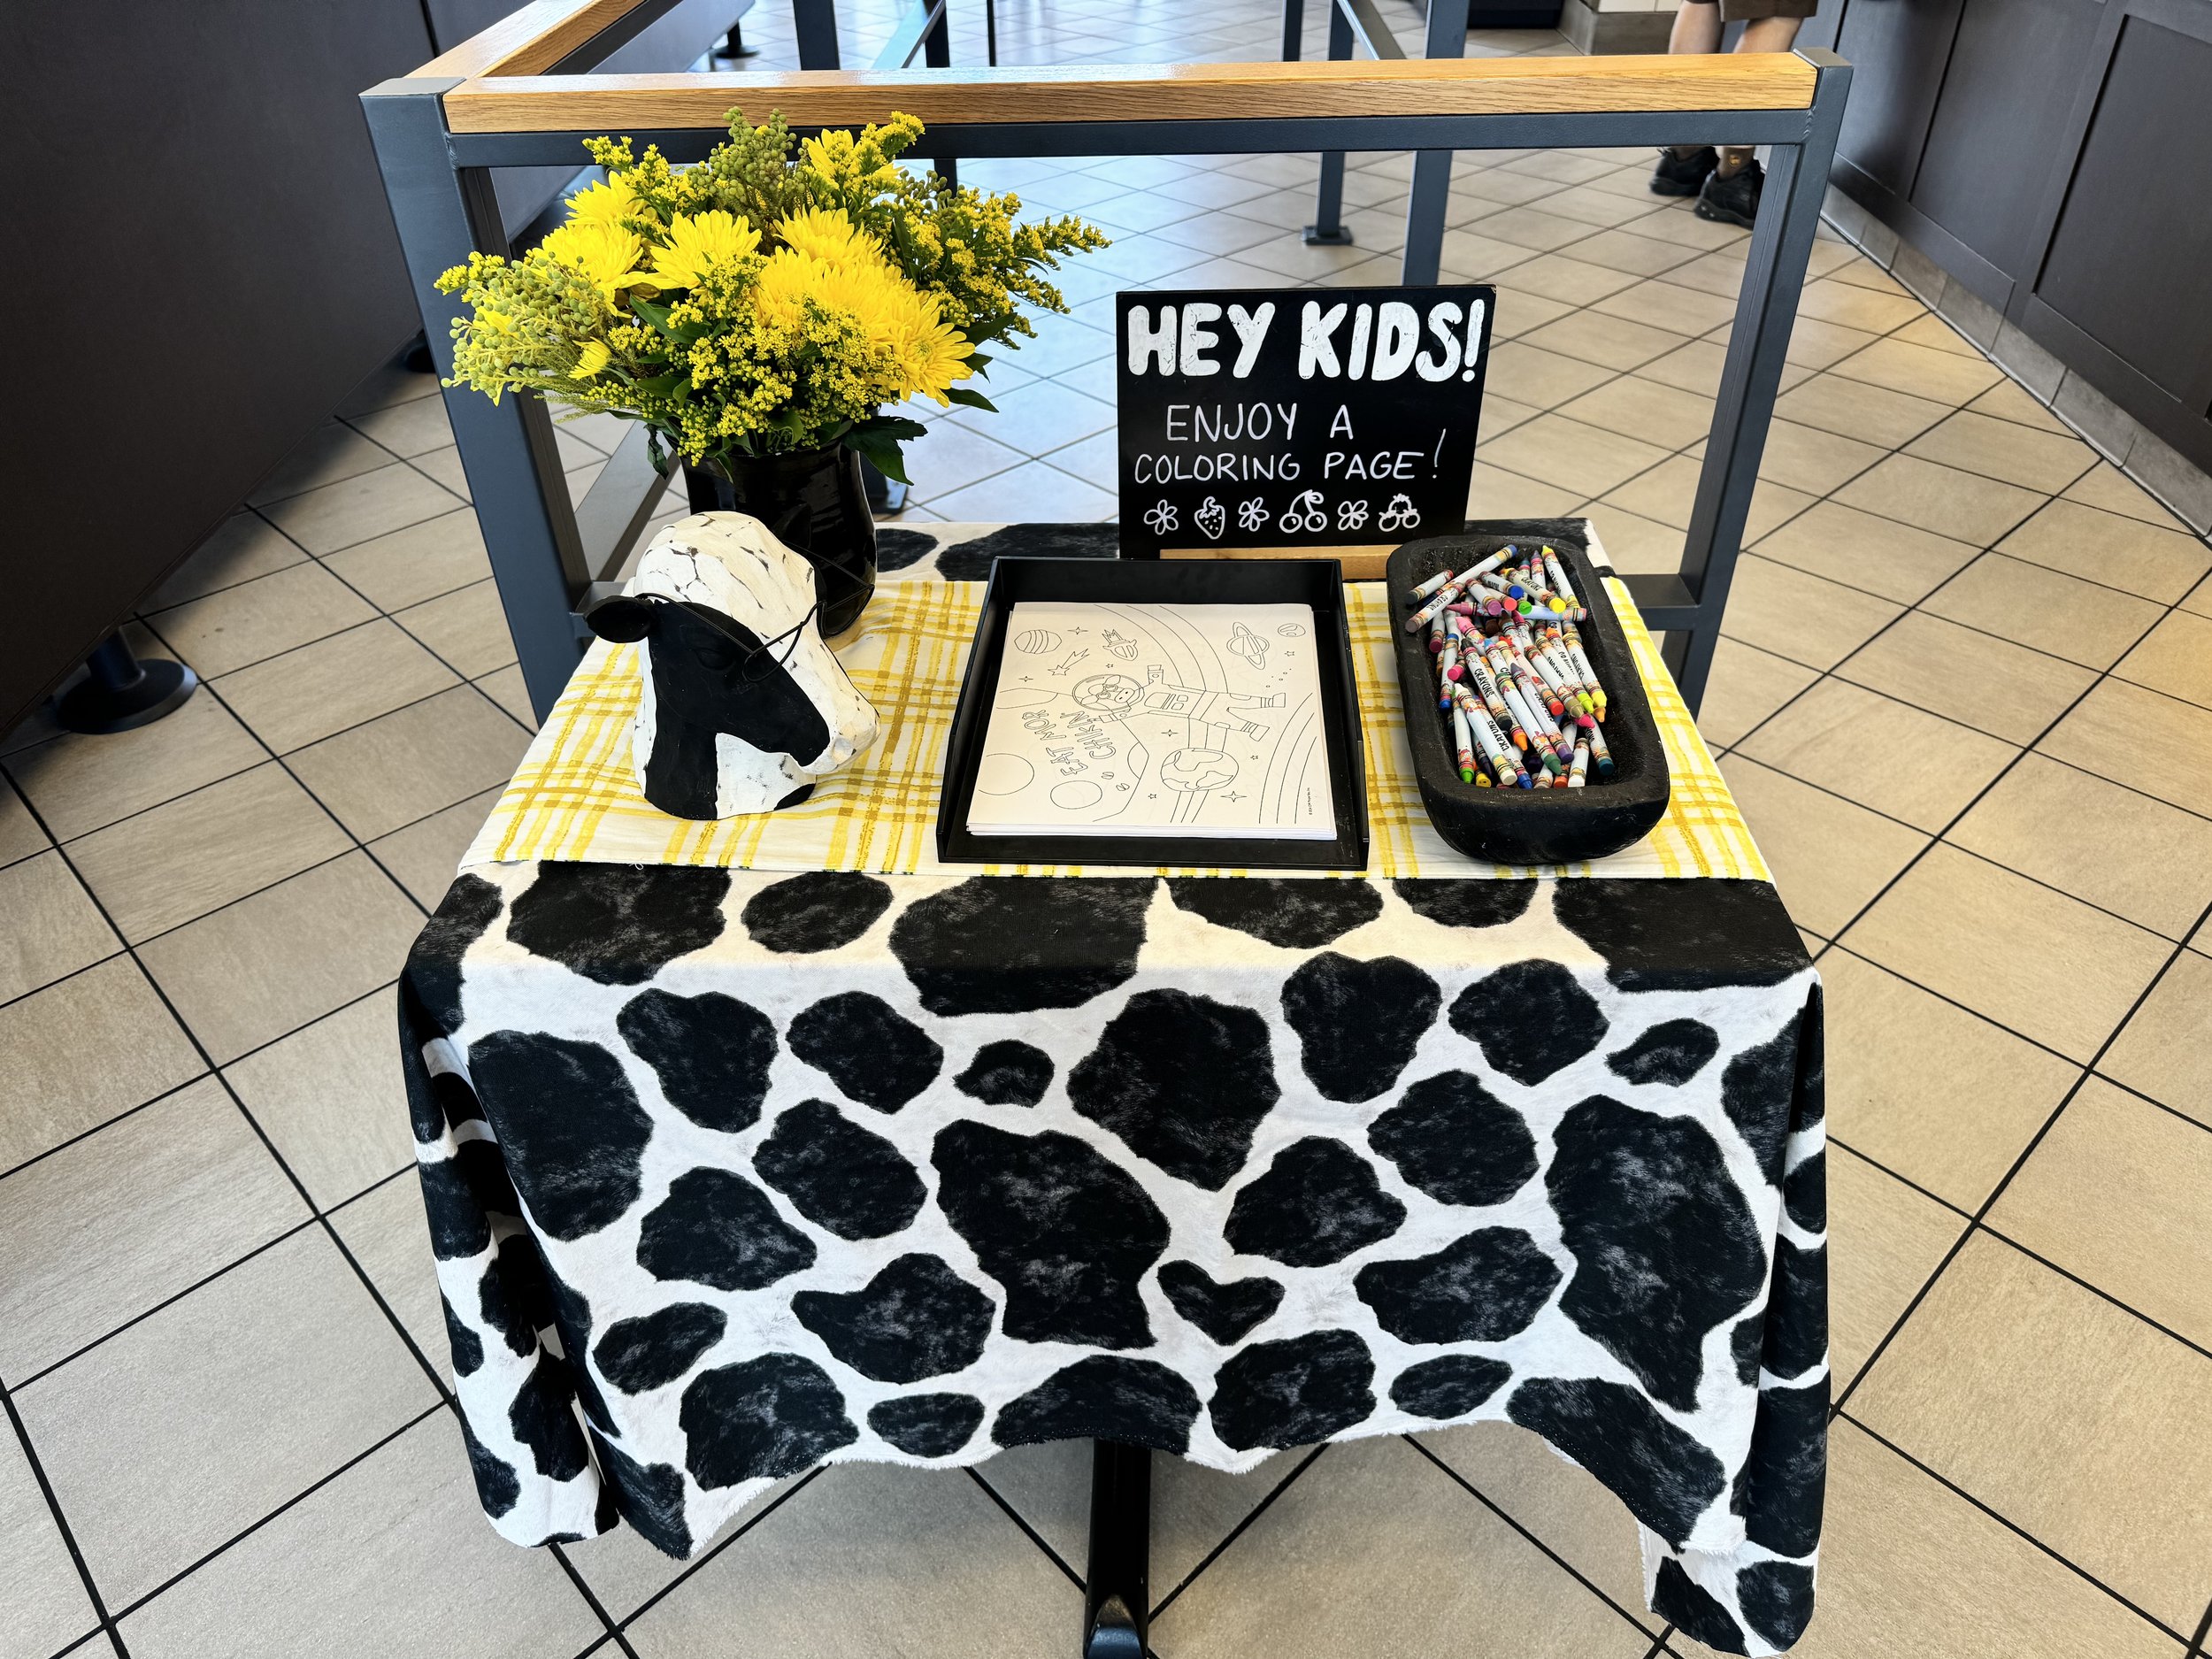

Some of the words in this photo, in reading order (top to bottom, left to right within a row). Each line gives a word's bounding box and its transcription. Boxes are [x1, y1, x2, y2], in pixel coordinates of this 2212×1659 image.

[1127, 302, 1276, 379] HEY
[1298, 298, 1485, 382] KIDS!
[1166, 403, 1297, 442] ENJOY
[1330, 403, 1354, 440] A
[1134, 452, 1301, 484] COLORING
[1474, 668, 1495, 698] CRAYONS
[1022, 710, 1067, 741] MOR
[1060, 710, 1117, 760] CHIKIN
[1045, 747, 1088, 777] EAT
